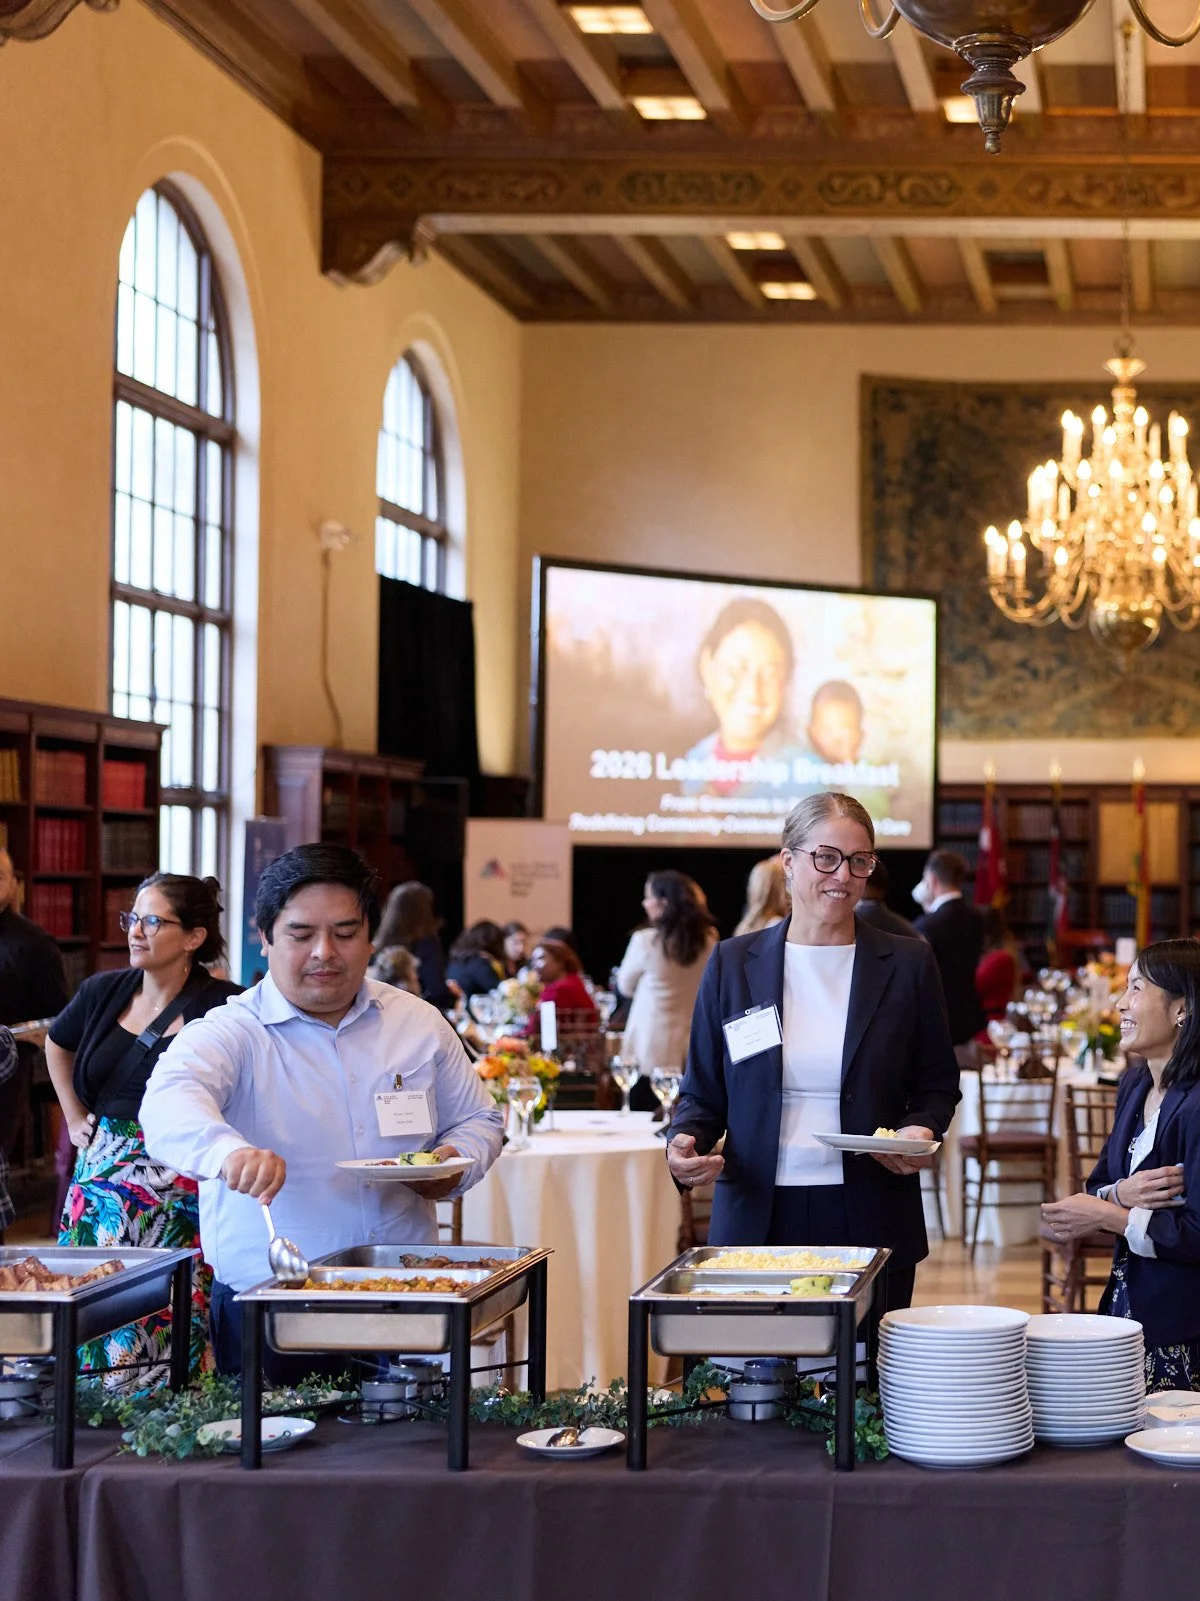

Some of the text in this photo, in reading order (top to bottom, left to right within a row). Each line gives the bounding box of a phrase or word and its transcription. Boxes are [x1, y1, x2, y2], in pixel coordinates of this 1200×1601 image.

[590, 749, 899, 787] 2026 Leadership Breakfast
